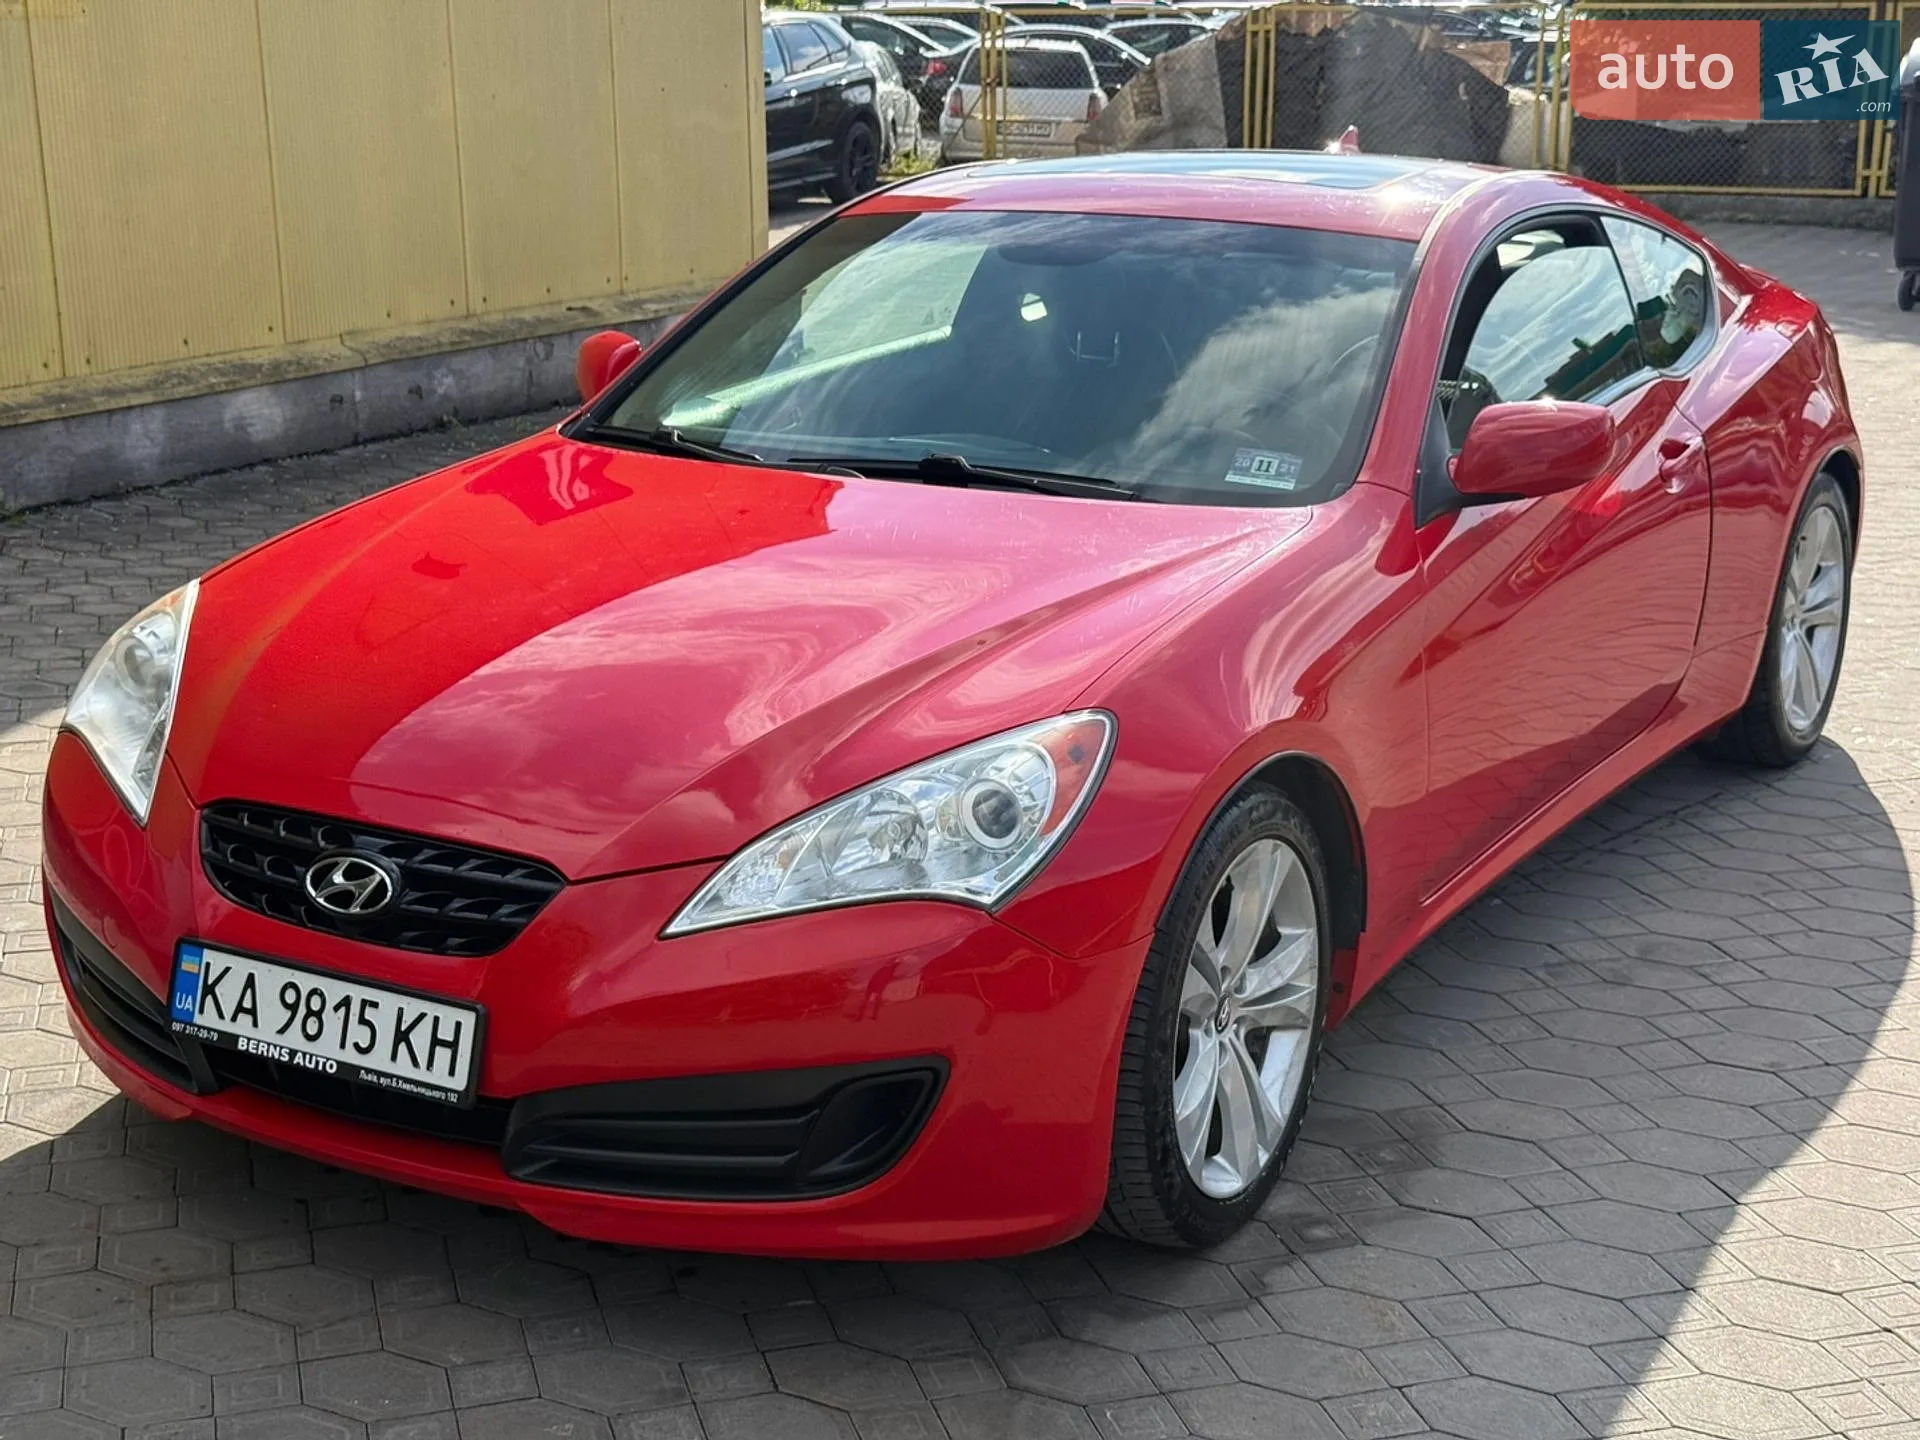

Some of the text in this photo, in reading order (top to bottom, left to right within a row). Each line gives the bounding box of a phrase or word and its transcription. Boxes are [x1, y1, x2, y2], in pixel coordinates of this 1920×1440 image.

[1255, 459, 1273, 473] 11
[175, 992, 193, 1012] UA
[198, 961, 462, 1077] KA 9815 KH
[237, 1037, 338, 1074] BERNS AUTO
